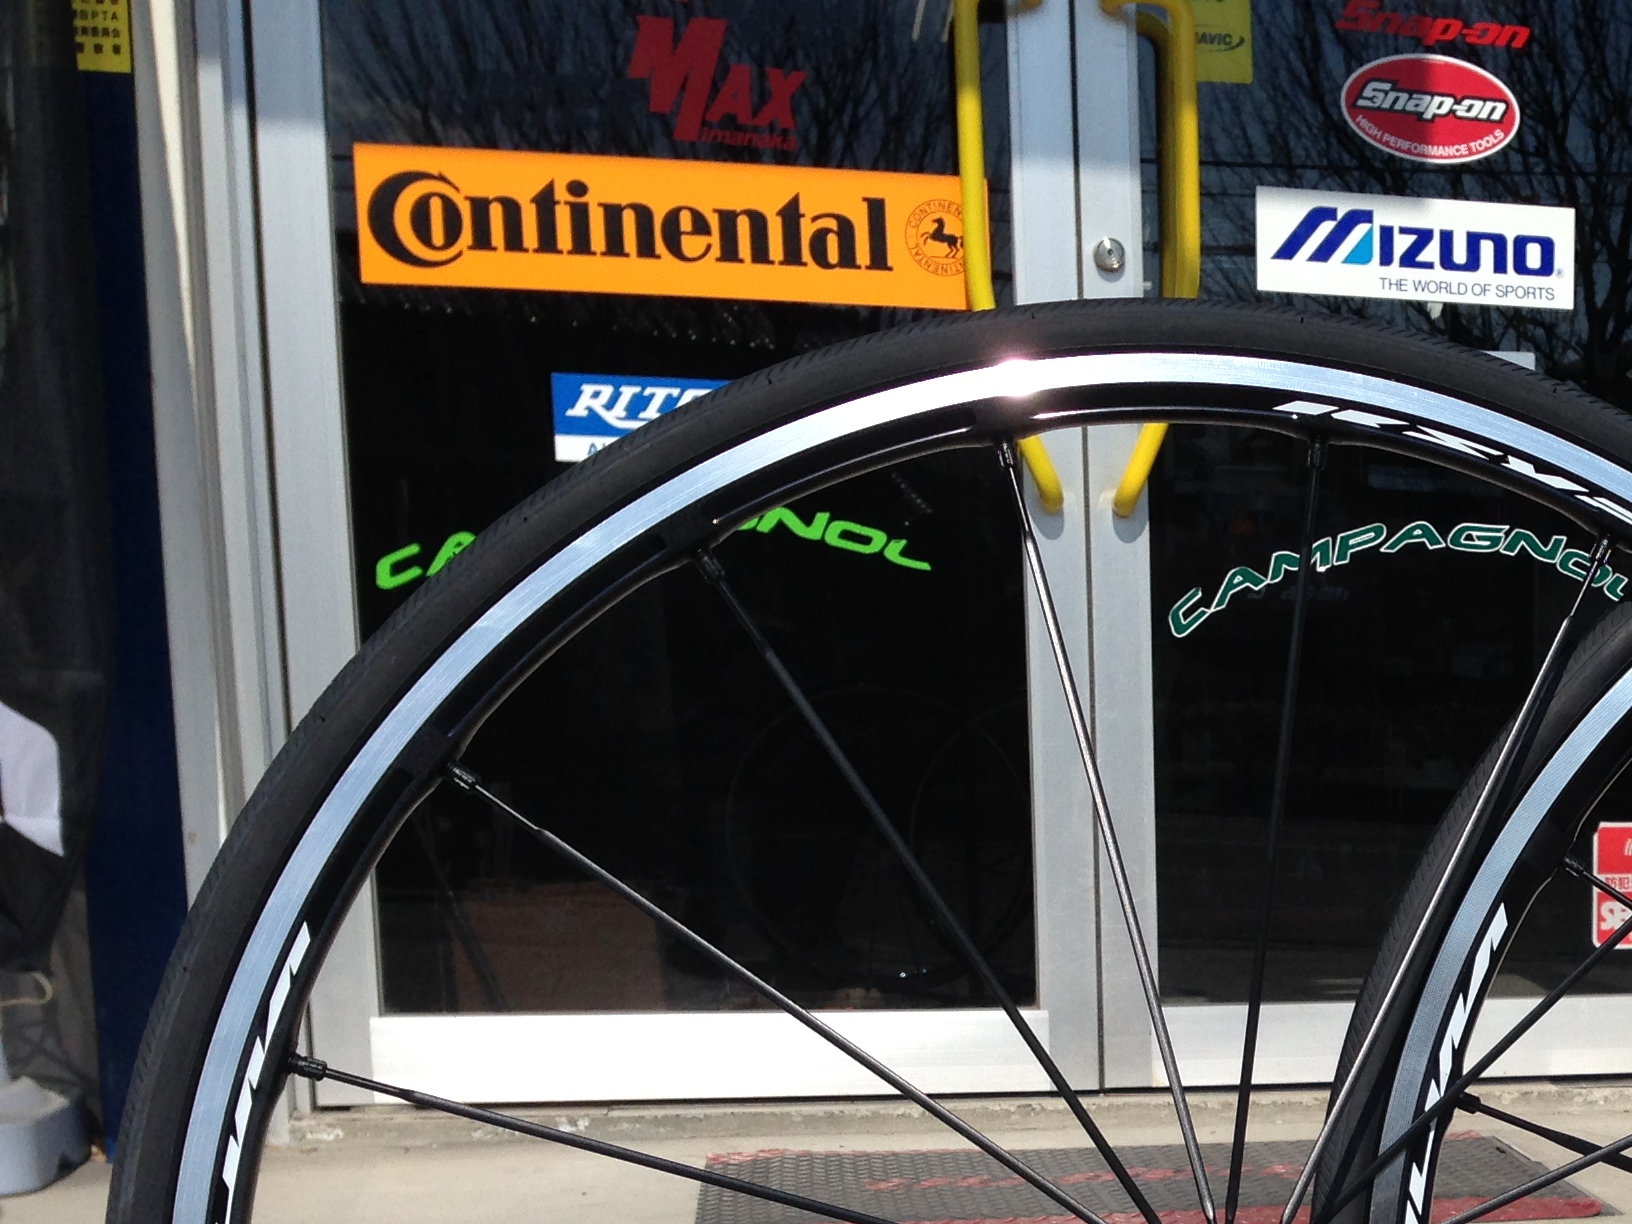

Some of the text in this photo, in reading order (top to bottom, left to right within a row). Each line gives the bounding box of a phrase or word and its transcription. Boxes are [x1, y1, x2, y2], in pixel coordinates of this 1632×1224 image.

[1335, 0, 1531, 48] Snap-on
[1355, 80, 1508, 121] Snap-on
[1356, 114, 1505, 156] HIGH PERFORMANCE TOOLS
[368, 170, 894, 272] Continental
[1270, 206, 1555, 277] MIZUNO
[1379, 277, 1555, 301] THE WORLD OF SPORTS
[376, 507, 932, 590] CANOL
